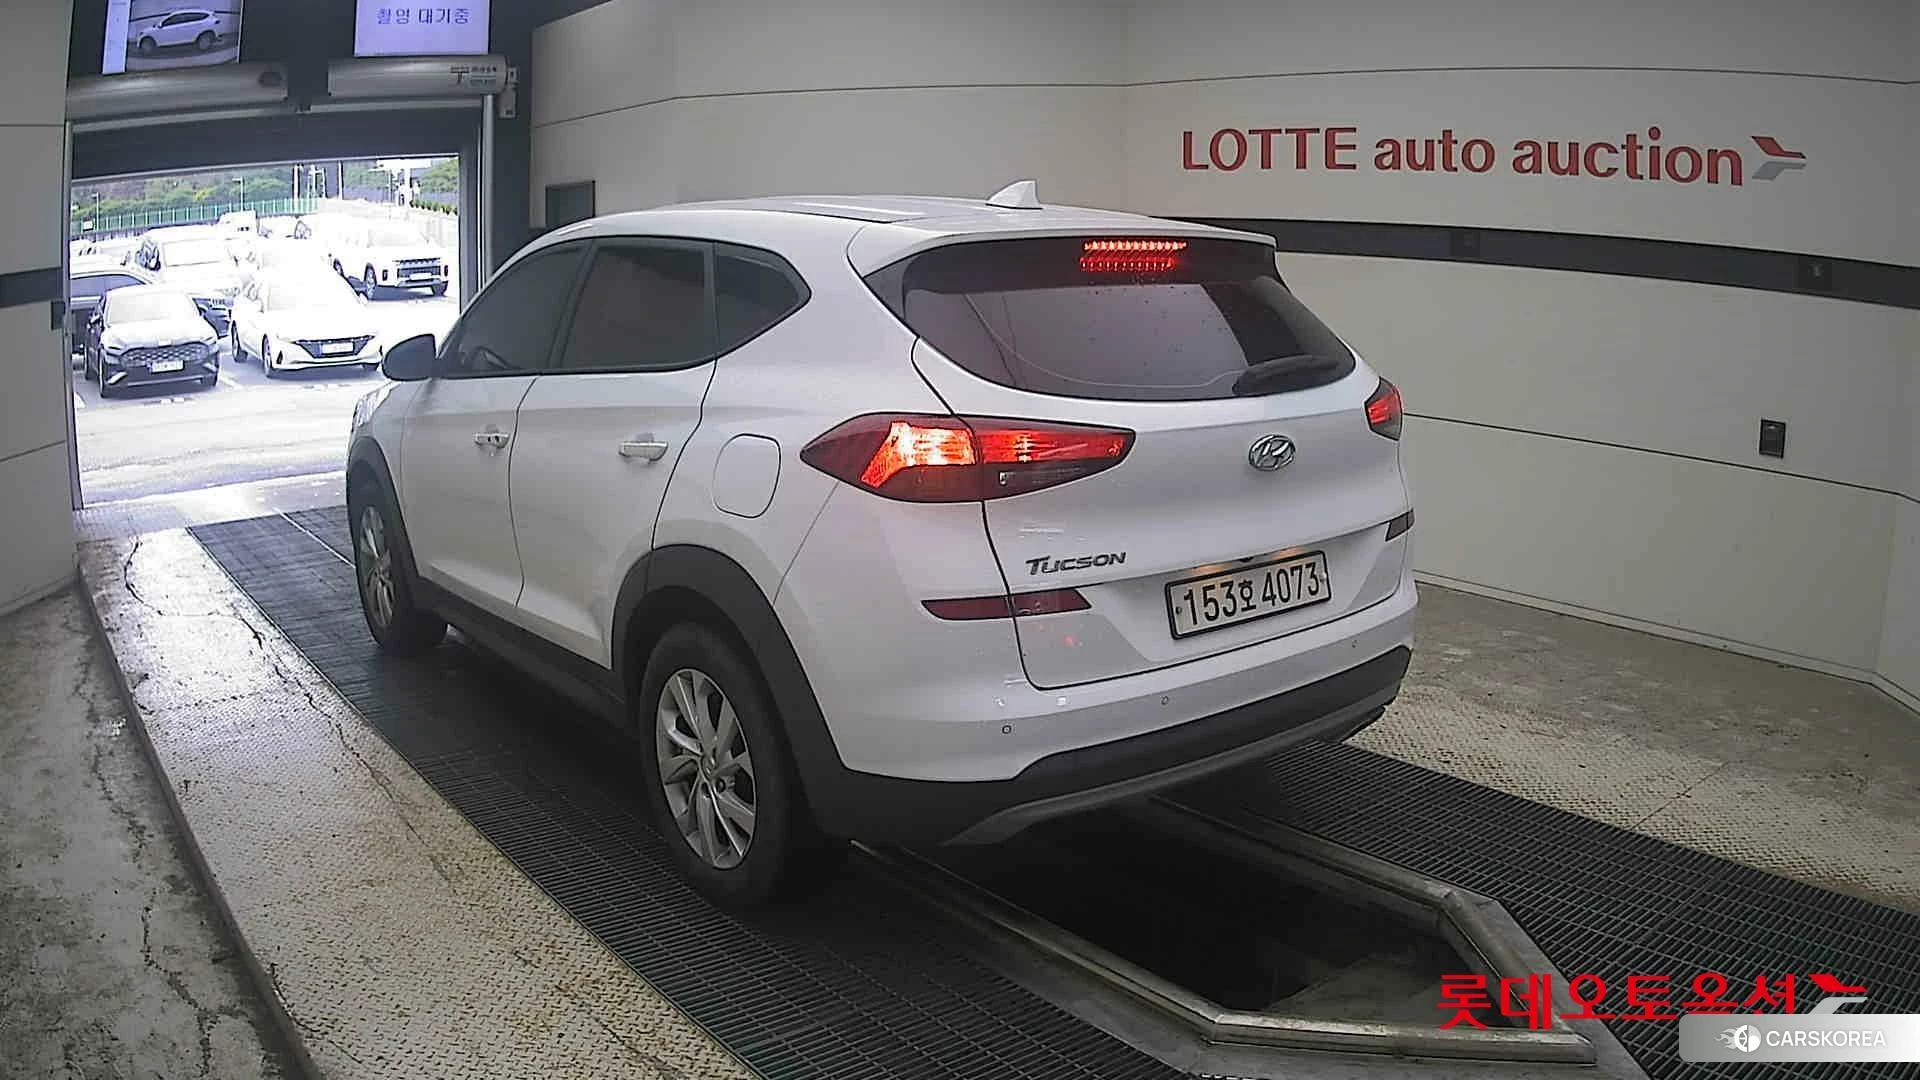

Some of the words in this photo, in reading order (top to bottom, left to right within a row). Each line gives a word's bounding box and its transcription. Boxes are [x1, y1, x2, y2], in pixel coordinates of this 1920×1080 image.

[418, 8, 469, 24] 대기중
[1182, 127, 1357, 171] LOTTE
[1374, 129, 1496, 173] auto
[1512, 126, 1743, 186] auction
[1183, 579, 1256, 625] 153호
[1261, 562, 1319, 606] 4073
